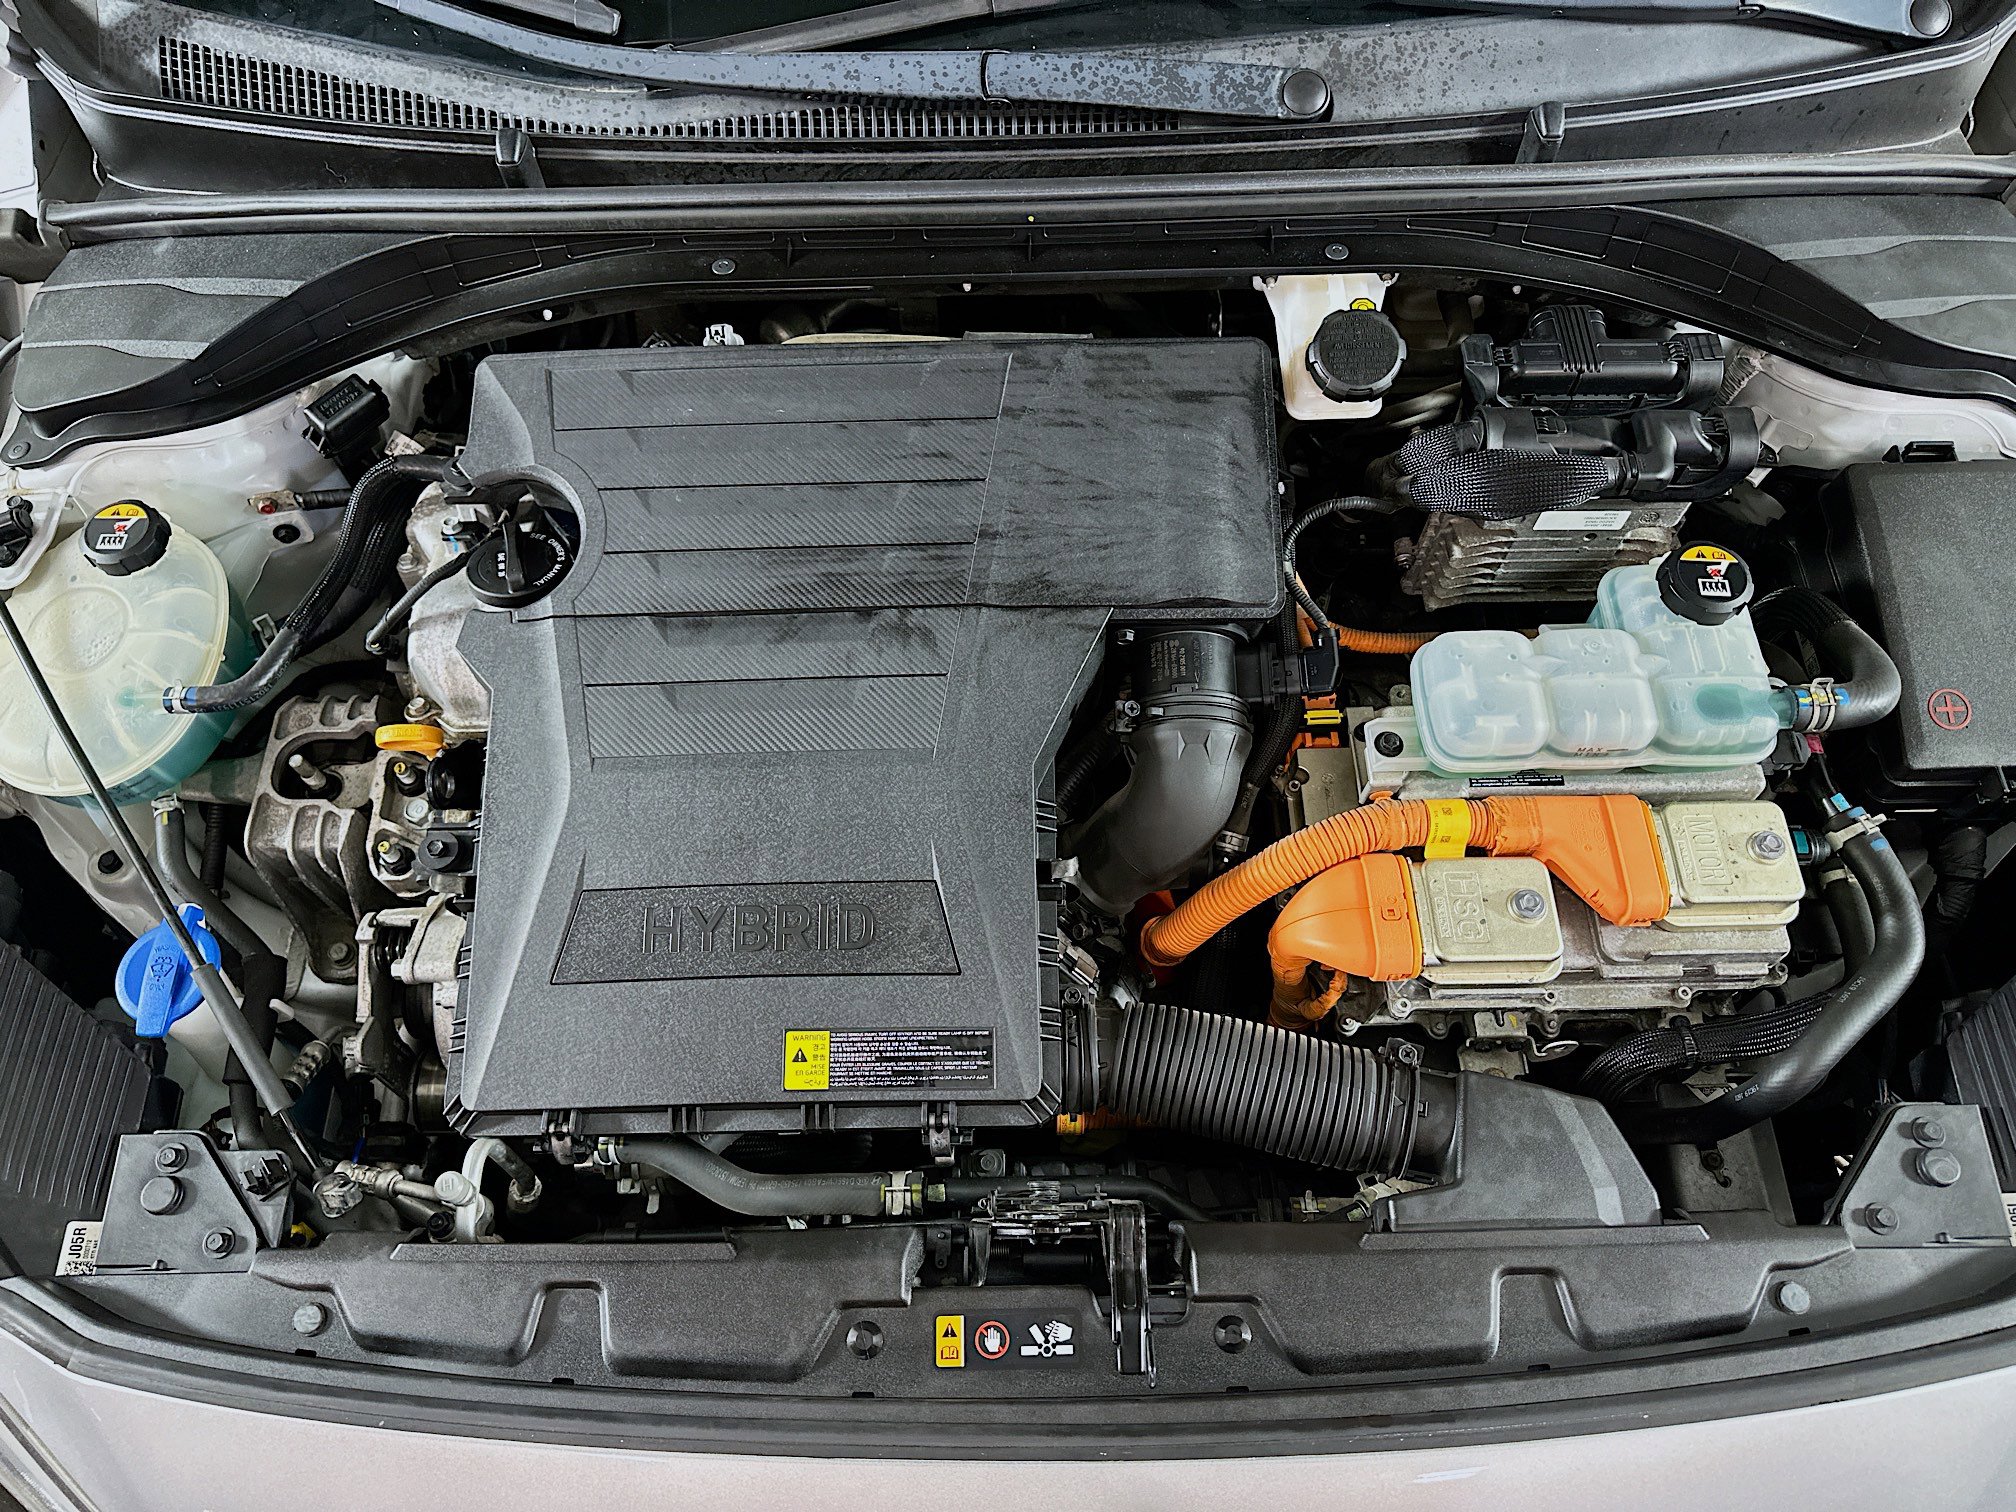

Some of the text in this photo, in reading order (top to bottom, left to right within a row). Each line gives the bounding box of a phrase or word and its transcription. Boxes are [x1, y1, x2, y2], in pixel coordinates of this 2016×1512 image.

[548, 538, 566, 562] OWNER'S
[533, 564, 562, 587] MANUAL
[1688, 820, 1727, 879] MOTOR
[1448, 872, 1484, 939] HSG
[642, 903, 875, 953] HYBRID
[441, 1178, 454, 1192] H
[68, 1227, 87, 1259] J05R
